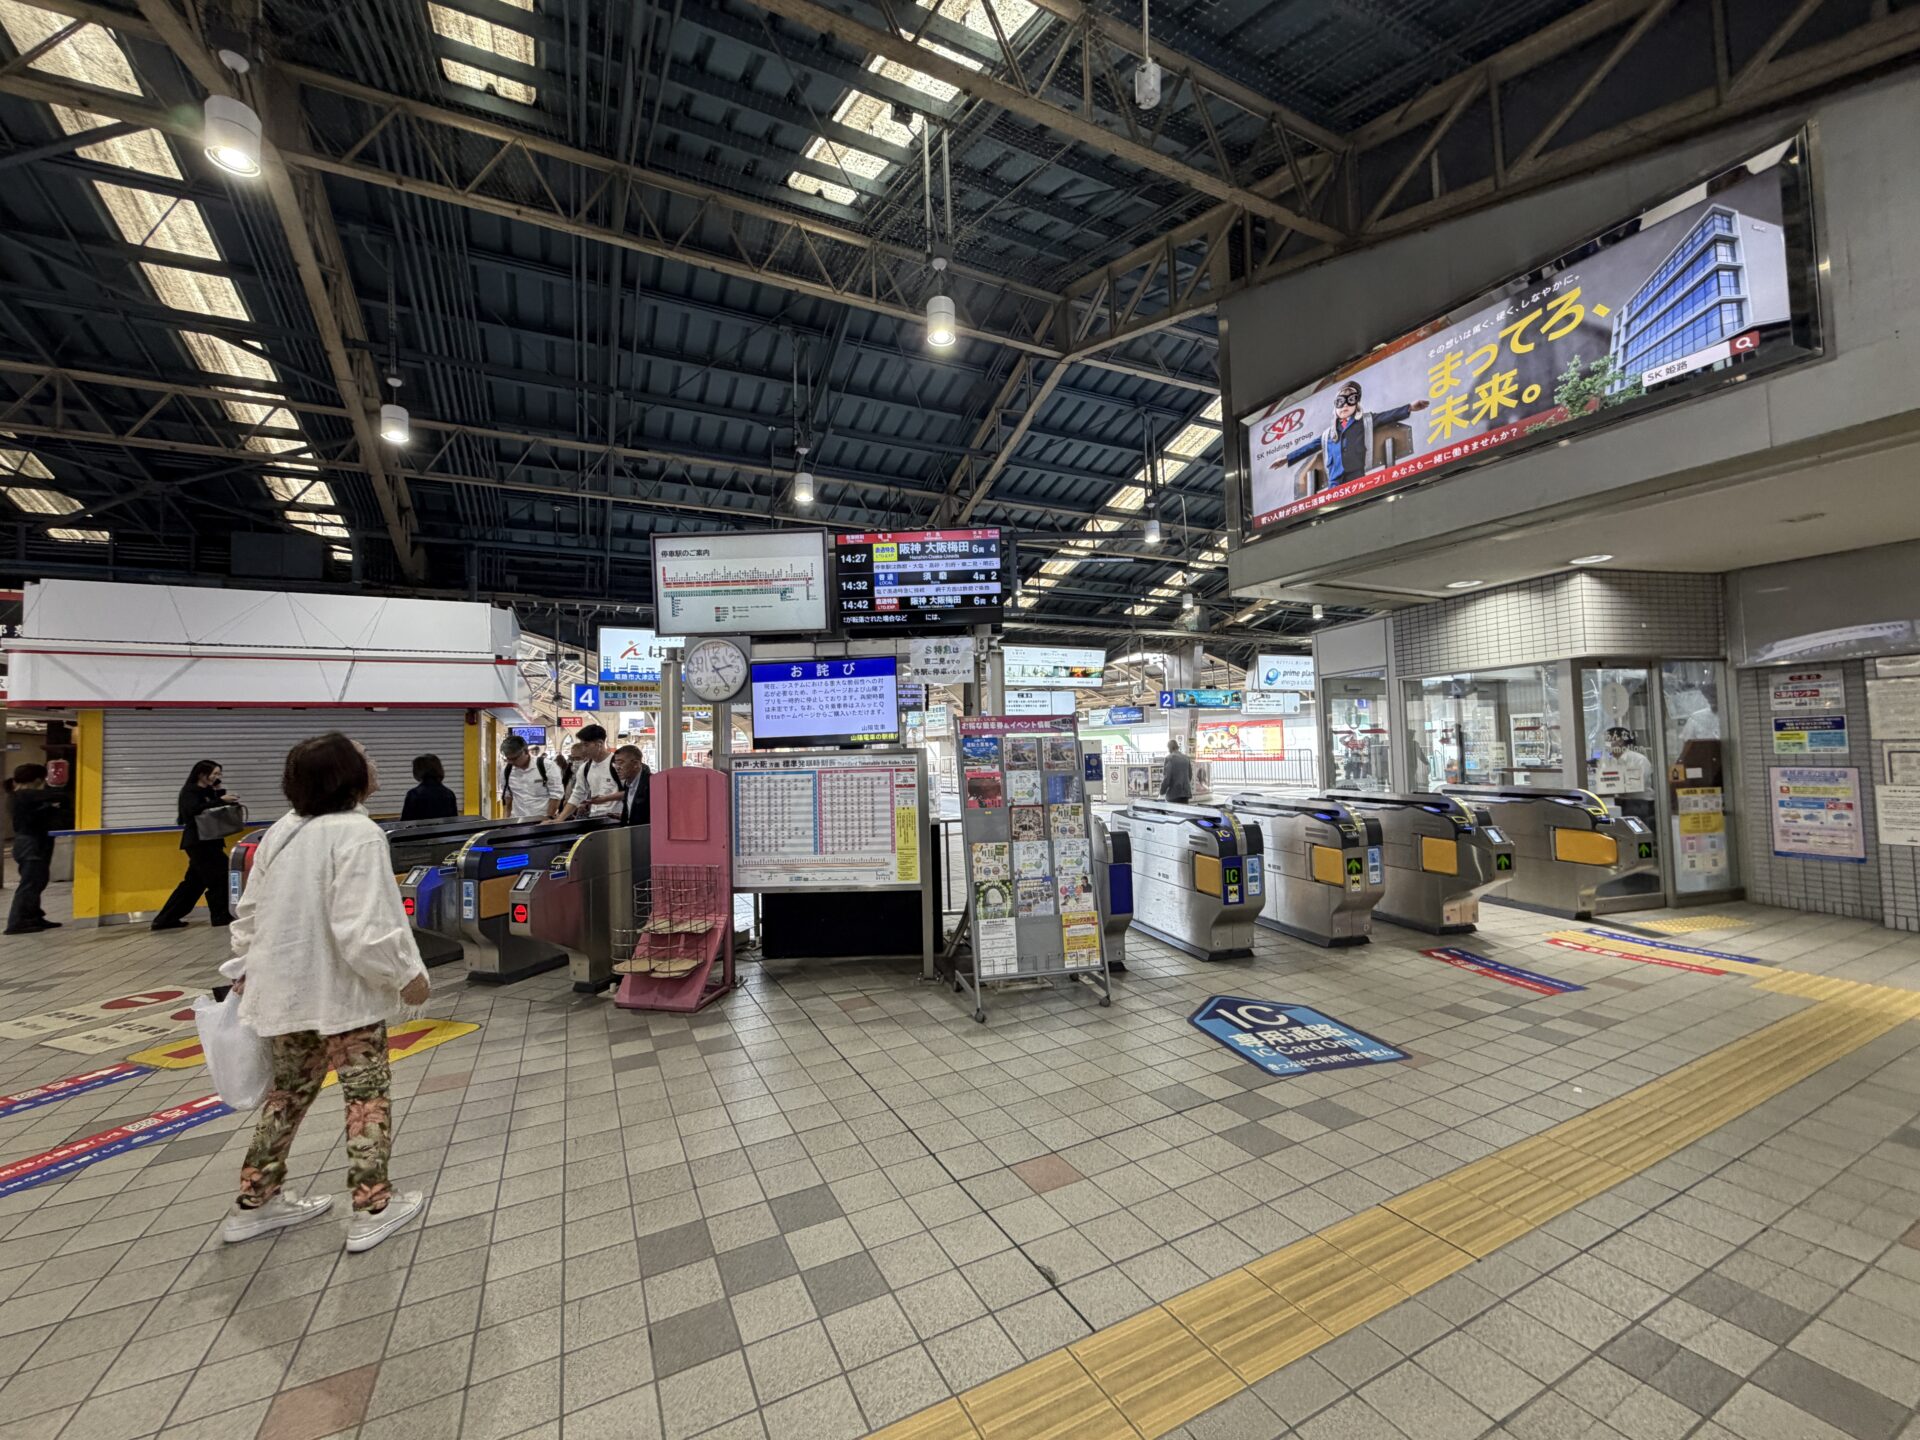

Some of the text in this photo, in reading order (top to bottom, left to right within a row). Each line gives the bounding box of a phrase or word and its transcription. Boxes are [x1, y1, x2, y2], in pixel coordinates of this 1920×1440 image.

[1428, 286, 1611, 398] まってろ、
[1647, 361, 1688, 381] SK 姫路
[1427, 369, 1541, 444] 未来。
[1256, 431, 1314, 461] SK Holdings group
[660, 549, 710, 557] 停車駅のご案内
[840, 554, 867, 564] 14:27
[899, 543, 921, 554] 阪神
[925, 541, 969, 553] 大阪梅田
[990, 543, 996, 553] 4
[841, 581, 868, 591] 14:32
[990, 571, 997, 580] 2
[842, 600, 869, 609] 14:42
[910, 597, 926, 606] 阪神
[929, 595, 962, 605] 大阪梅田
[991, 596, 998, 605] 4
[924, 645, 959, 655] S特急は
[924, 657, 960, 665] 東二見までの
[734, 665, 740, 673] 3
[791, 662, 855, 678] お詫び
[913, 668, 971, 676] 各駅に停車いたします
[1282, 669, 1301, 678] prime
[696, 677, 703, 685] 8
[579, 689, 595, 708] 4
[713, 686, 720, 696] 6
[1162, 695, 1171, 707] 2
[861, 724, 886, 732] 山陽電車
[1216, 830, 1231, 838] IC
[1225, 868, 1238, 883] IC
[1216, 1005, 1289, 1029] IC
[1228, 1023, 1349, 1049] 専用通路
[1252, 1036, 1364, 1058] IC Card Only
[1266, 1049, 1395, 1072] きっぷはご利用できません
